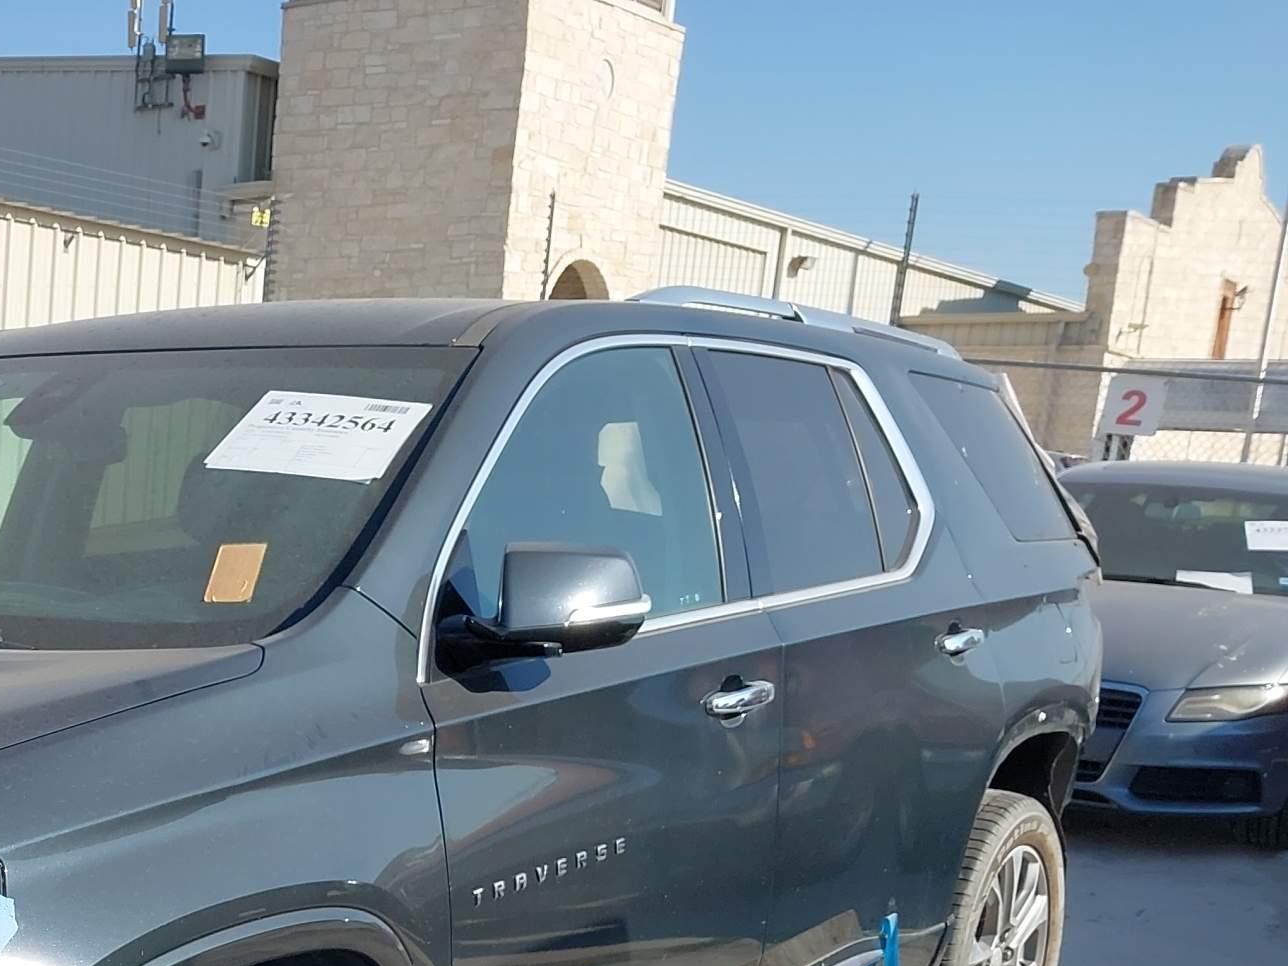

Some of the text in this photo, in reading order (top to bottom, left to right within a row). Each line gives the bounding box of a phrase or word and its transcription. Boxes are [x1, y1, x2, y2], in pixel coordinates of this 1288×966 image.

[263, 410, 398, 433] 43342564
[1115, 389, 1148, 427] 2
[471, 837, 628, 909] TRAVERSE
